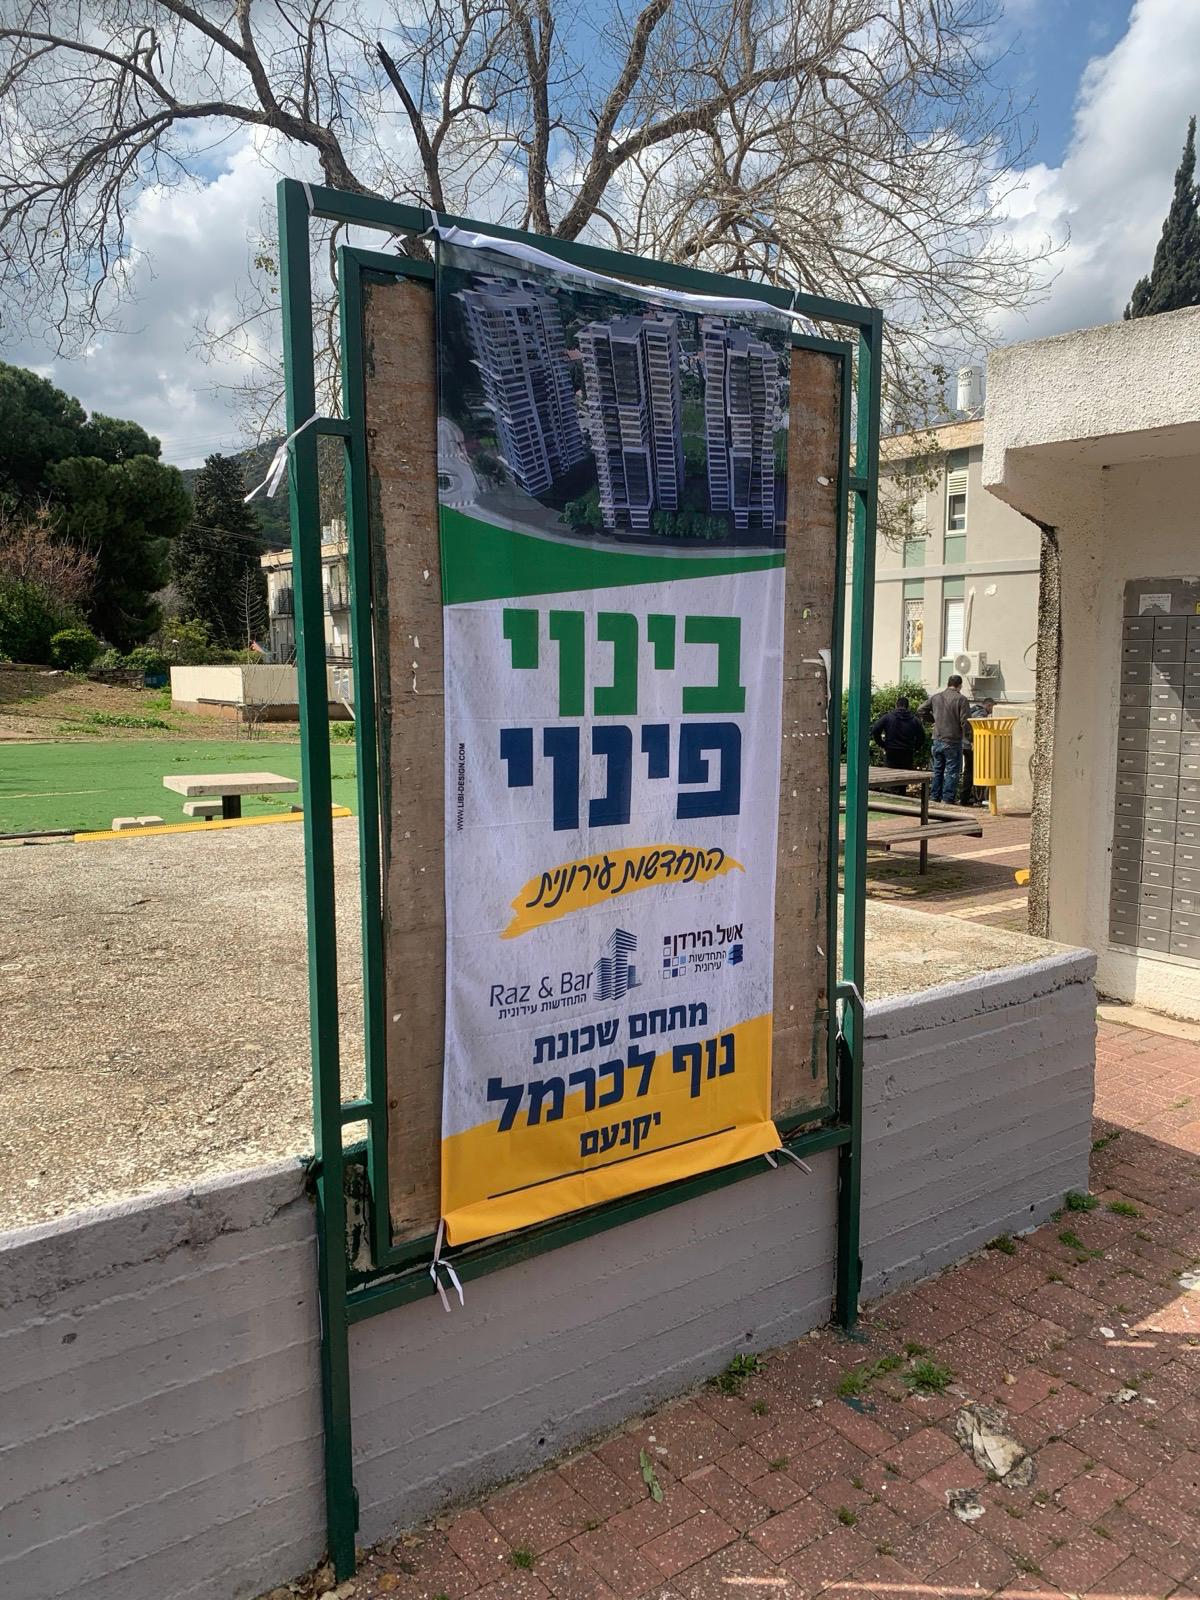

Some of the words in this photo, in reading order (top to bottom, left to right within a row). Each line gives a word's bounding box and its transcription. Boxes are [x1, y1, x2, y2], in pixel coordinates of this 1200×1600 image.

[503, 608, 746, 717] בינוי
[457, 742, 466, 832] WWW.LIBI-DESIGN.COM
[500, 722, 742, 831] פינוי
[526, 856, 616, 908] עירונית
[611, 847, 725, 893] התחדשות
[673, 930, 713, 956] הירדן
[688, 950, 726, 963] התחדשות
[716, 923, 743, 945] אשל
[489, 984, 531, 1007] Raz
[538, 976, 553, 999] &
[560, 972, 593, 994] Bar
[694, 961, 722, 973] עירונית
[498, 1004, 537, 1019] עירונית
[540, 993, 587, 1012] התחדשות
[629, 1002, 708, 1039] מתחם
[533, 1018, 619, 1065] שכונת
[672, 1033, 735, 1098] נוף
[486, 1045, 656, 1132] לכרמל
[579, 1112, 661, 1157] יקנעם
